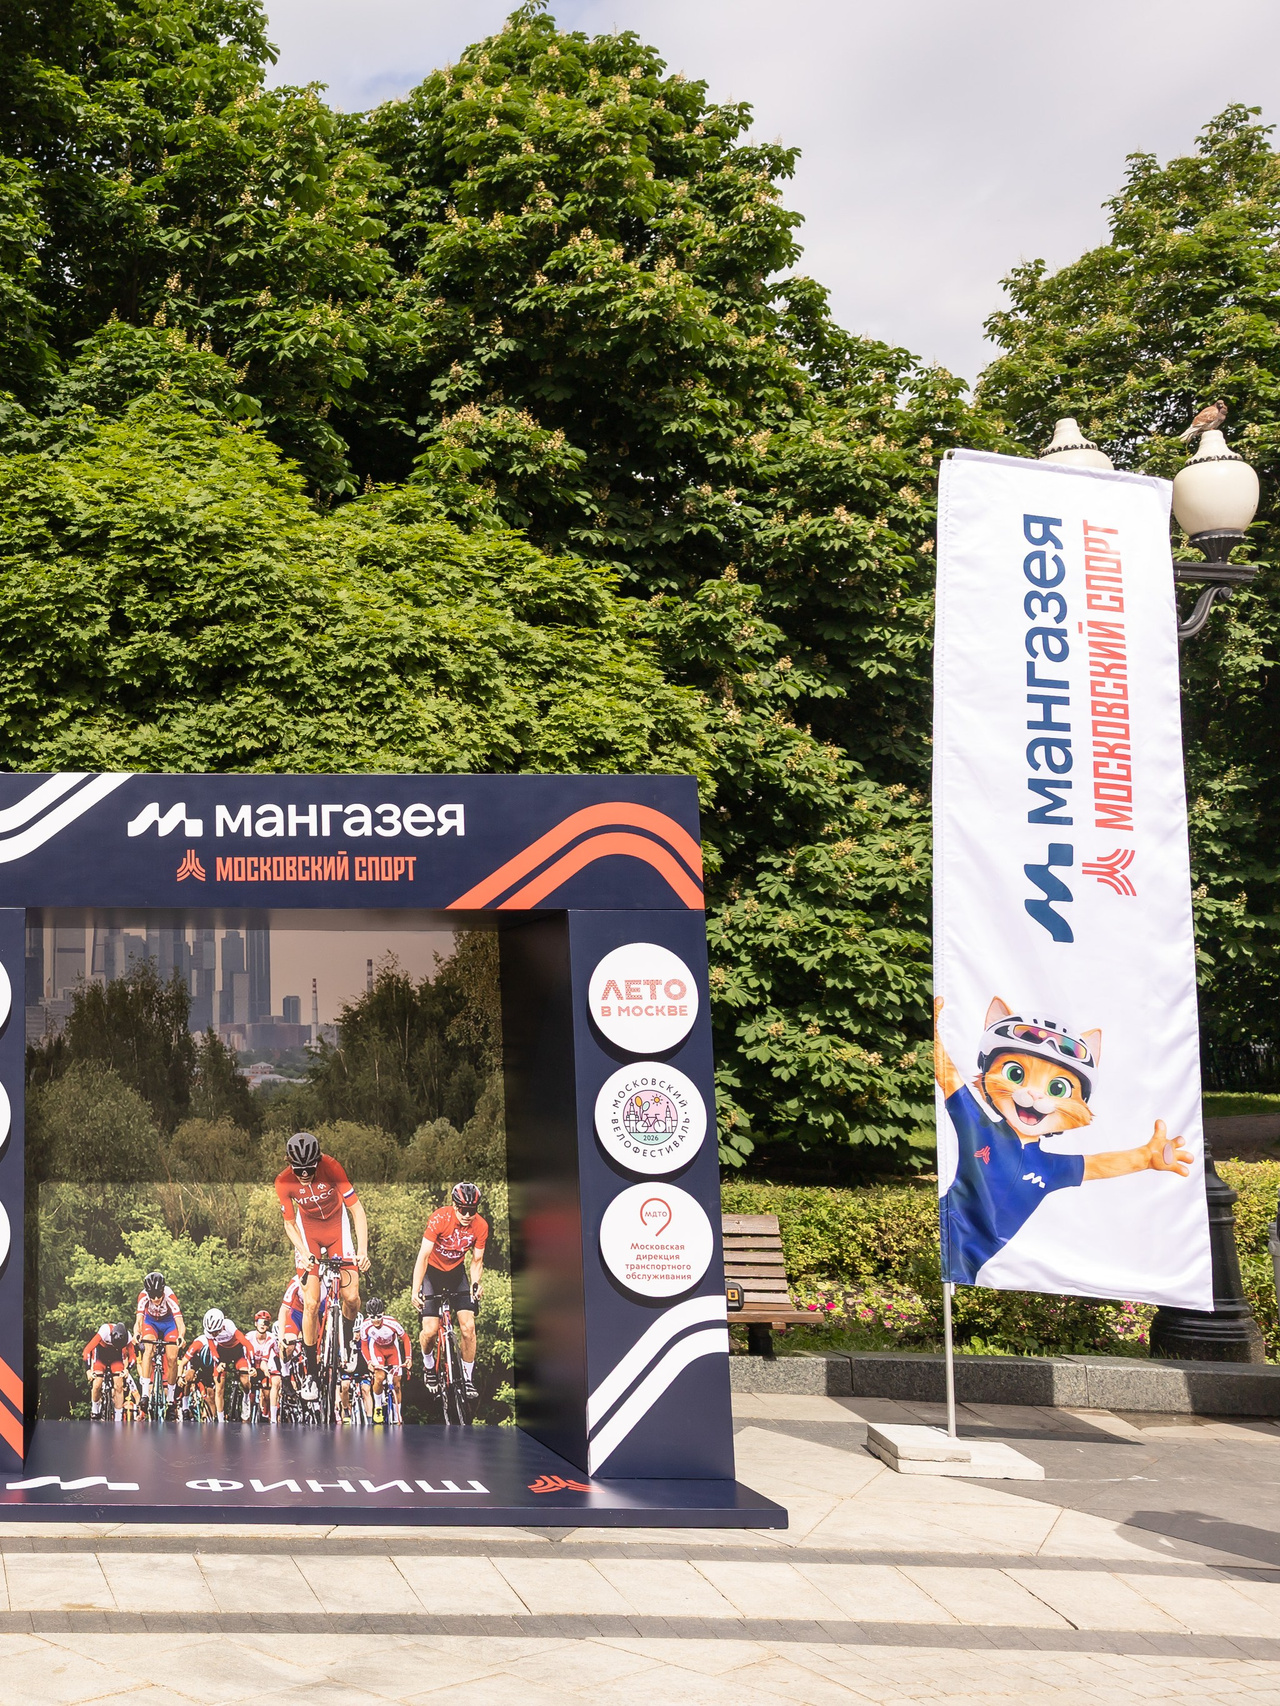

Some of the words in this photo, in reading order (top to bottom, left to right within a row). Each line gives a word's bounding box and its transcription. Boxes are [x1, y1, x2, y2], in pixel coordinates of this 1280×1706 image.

[1082, 519, 1125, 613] СПОРТ
[1023, 513, 1073, 825] мангазея
[1078, 620, 1134, 831] МОСКОВСКИЙ
[215, 803, 466, 838] мангазея
[216, 851, 350, 881] МОСКОВСКИЙ
[354, 856, 417, 881] СПОРТ
[601, 978, 687, 1001] ЛЕТО
[601, 1005, 612, 1017] В
[617, 1005, 688, 1017] МОСКВЕ
[612, 1077, 688, 1109] МОСКОВСКИЙ
[611, 1117, 690, 1158] ВЕЛОФЕСТИВАЛЬ
[630, 1242, 685, 1251] Московская
[636, 1253, 680, 1261] дирекция
[625, 1263, 692, 1272] транспортного
[625, 1272, 692, 1281] обслуживания
[185, 1478, 491, 1493] ФИНИШ
